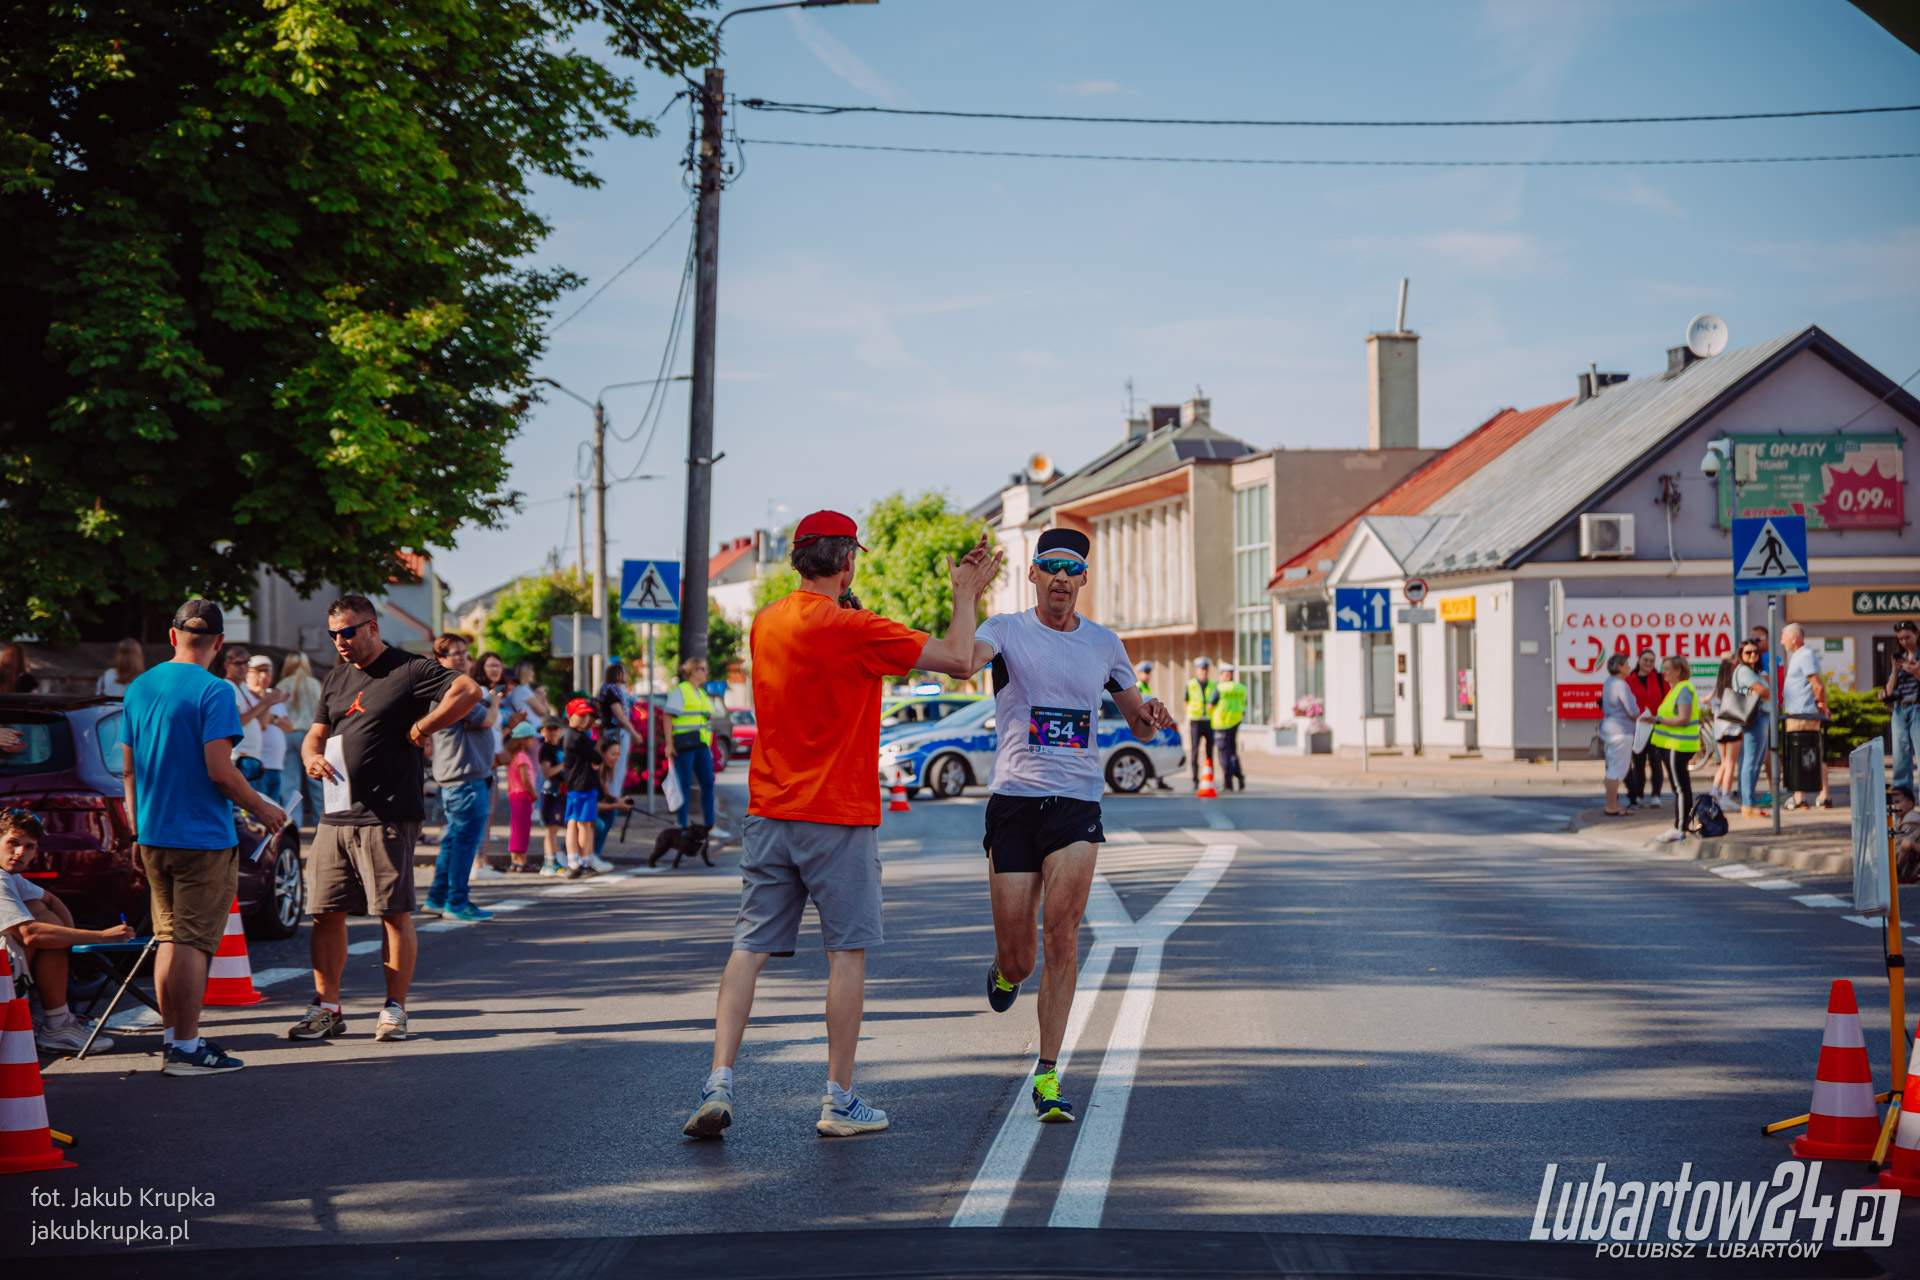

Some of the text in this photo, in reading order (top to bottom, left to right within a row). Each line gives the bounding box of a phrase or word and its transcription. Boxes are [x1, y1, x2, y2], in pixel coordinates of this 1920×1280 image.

[1567, 613, 1731, 628] CAŁODOBOWA
[1615, 633, 1731, 657] APTEKA
[1048, 720, 1075, 739] 54
